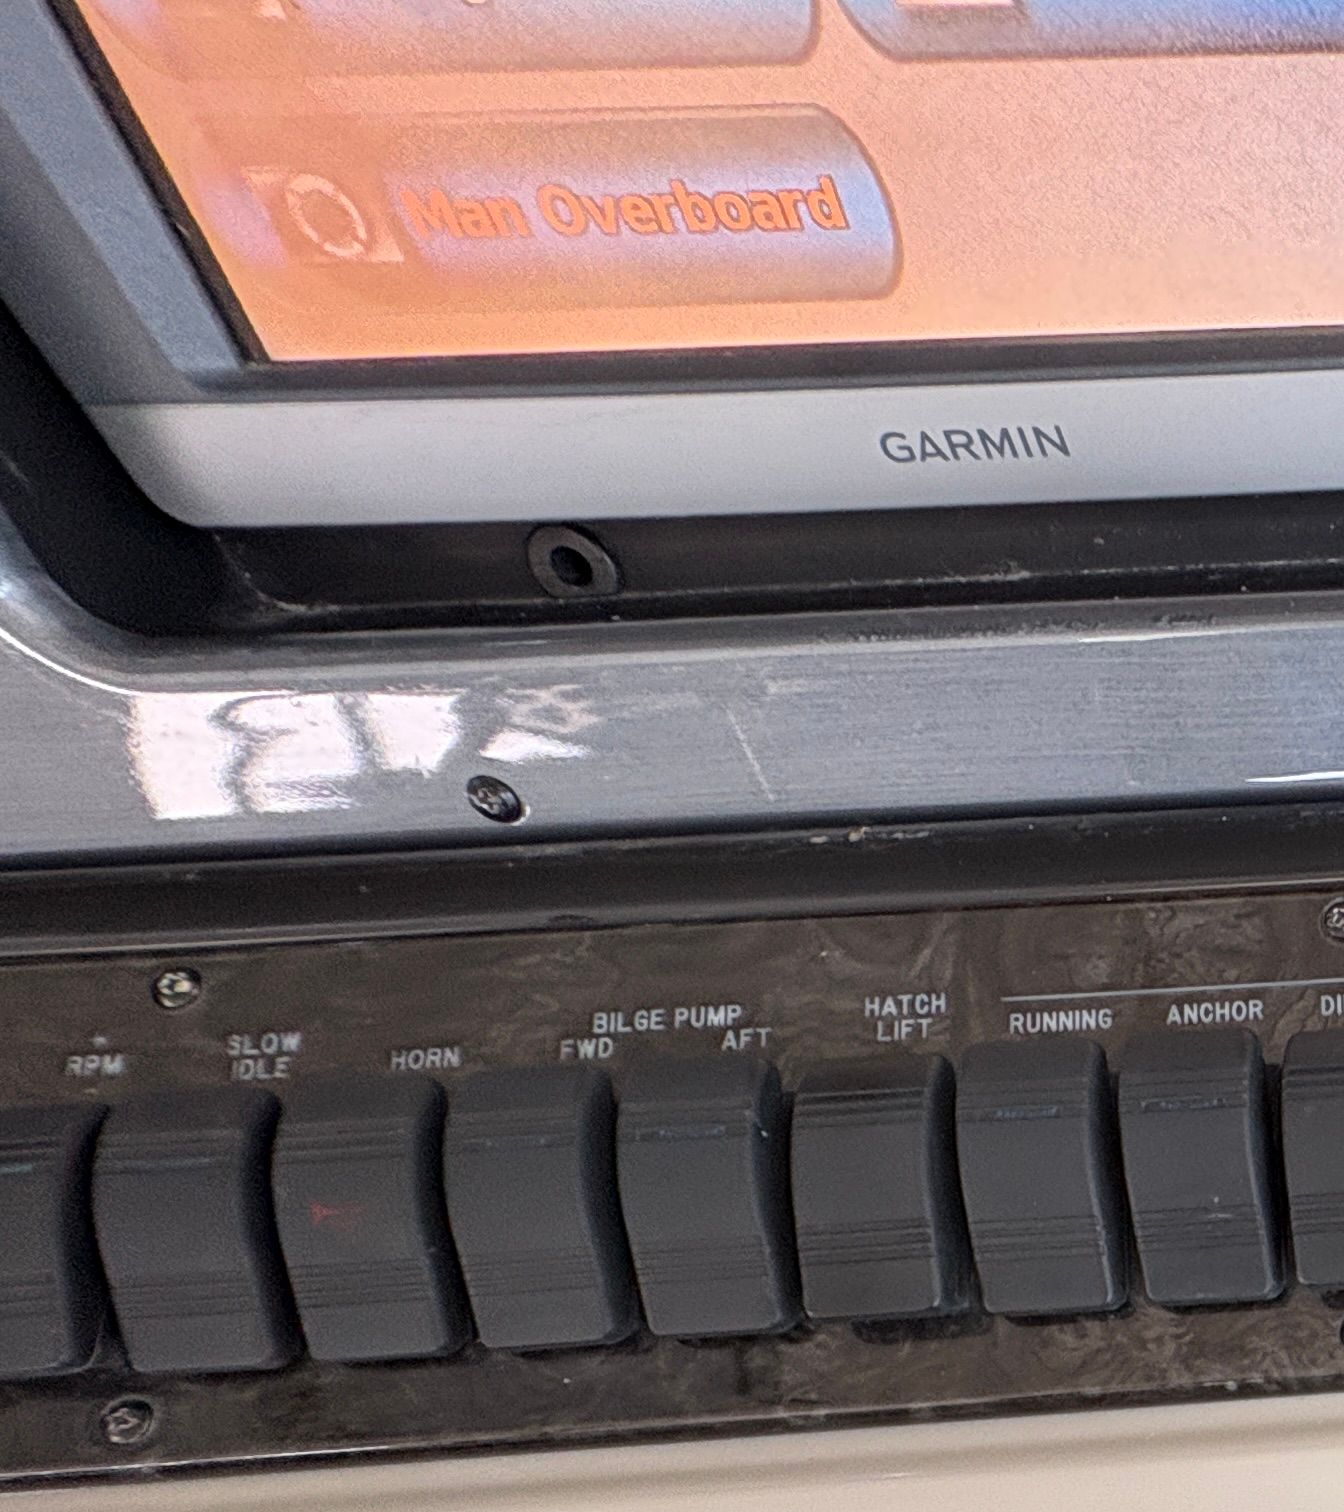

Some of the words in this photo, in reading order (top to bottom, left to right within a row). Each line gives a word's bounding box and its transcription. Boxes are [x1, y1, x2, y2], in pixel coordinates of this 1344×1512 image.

[400, 188, 533, 239] Man
[535, 174, 850, 238] Overboard
[880, 424, 1071, 463] GARMIN
[864, 992, 947, 1018] HATCH
[1166, 999, 1265, 1027] ANCHOR
[593, 1007, 664, 1035] BILGE
[673, 1003, 742, 1030] PUMP
[876, 1018, 933, 1043] LIFT
[1008, 1007, 1113, 1035] RUNNING
[226, 1030, 301, 1057] SLOW
[559, 1036, 614, 1061] FWD
[721, 1027, 773, 1052] AFT
[65, 1053, 126, 1078] RPM
[231, 1056, 291, 1081] IDLE
[390, 1045, 463, 1072] HORN
